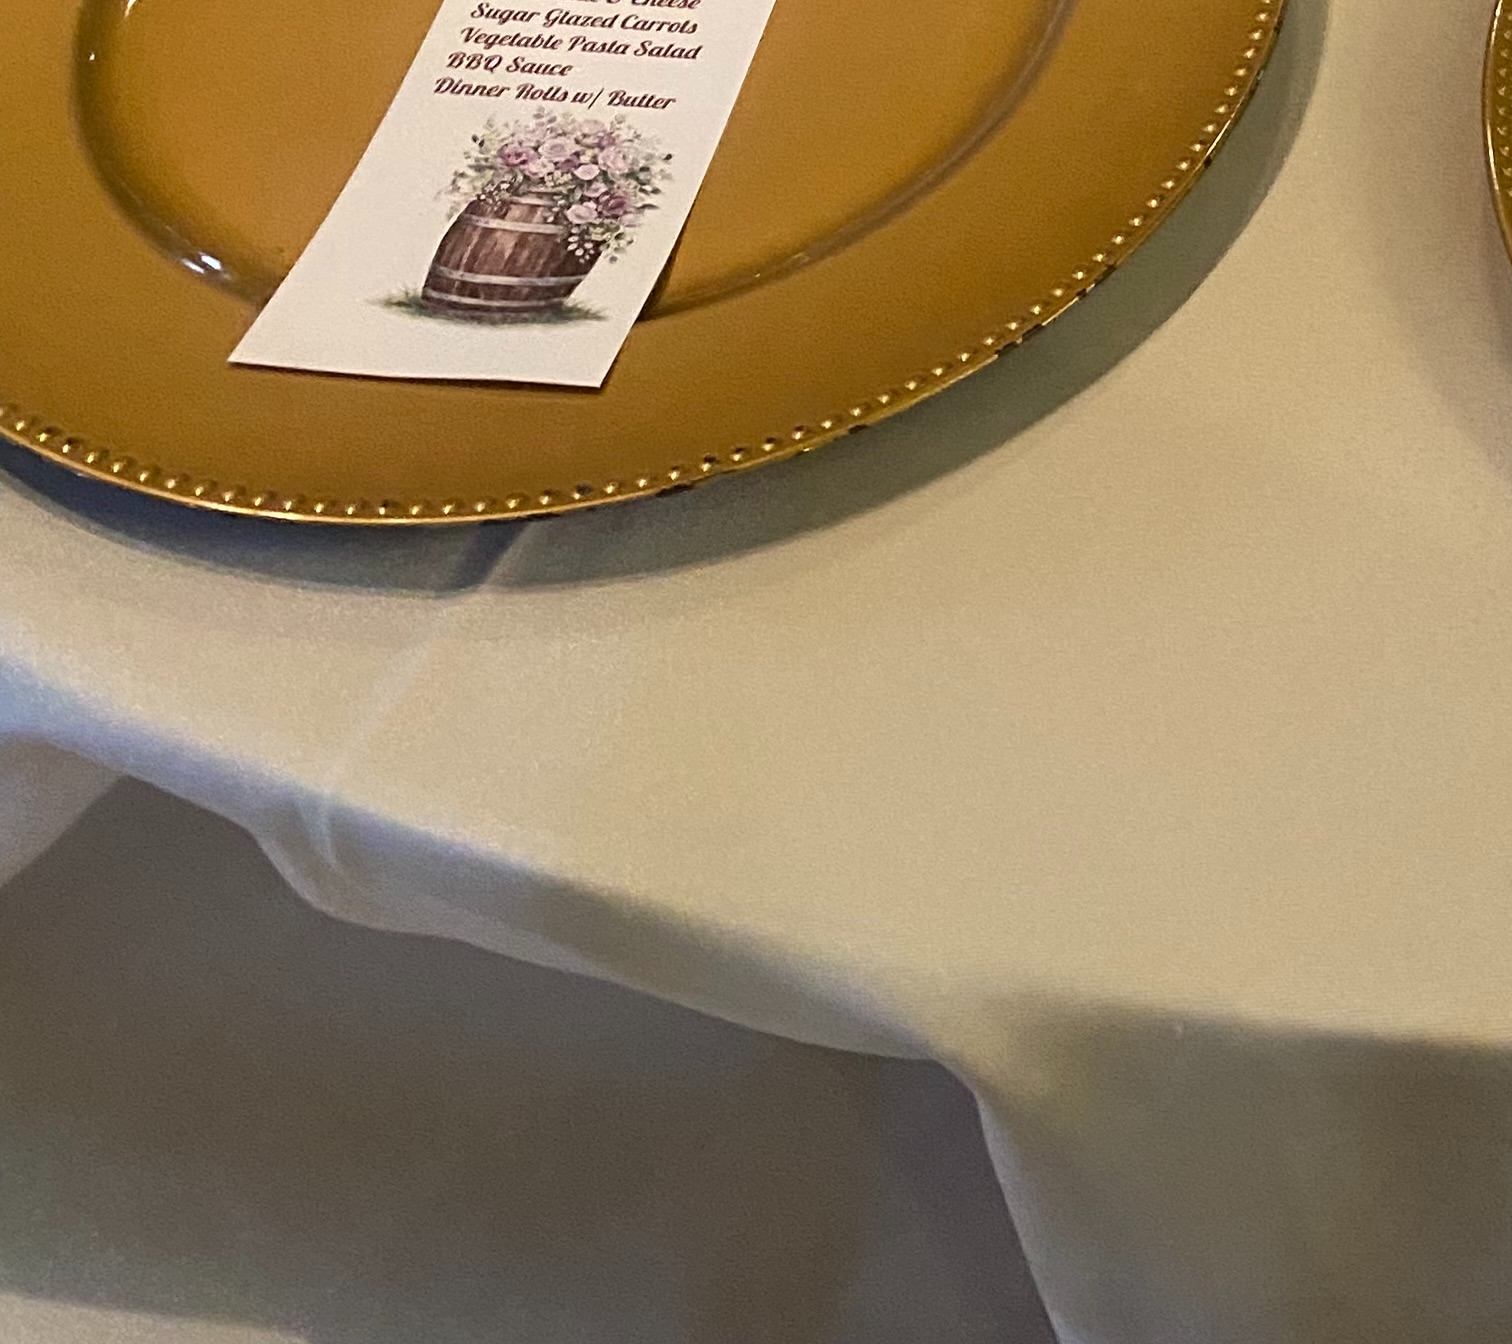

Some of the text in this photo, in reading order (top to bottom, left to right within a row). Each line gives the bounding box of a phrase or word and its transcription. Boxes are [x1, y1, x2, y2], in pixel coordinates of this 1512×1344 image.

[470, 2, 698, 35] Sugar Glazed Carrots
[460, 27, 703, 60] Vegetable Pasta Salad
[446, 52, 574, 77] BBQ Sauce
[433, 76, 510, 98] Dinner
[516, 82, 568, 103] Rolls
[607, 89, 676, 110] Butter
